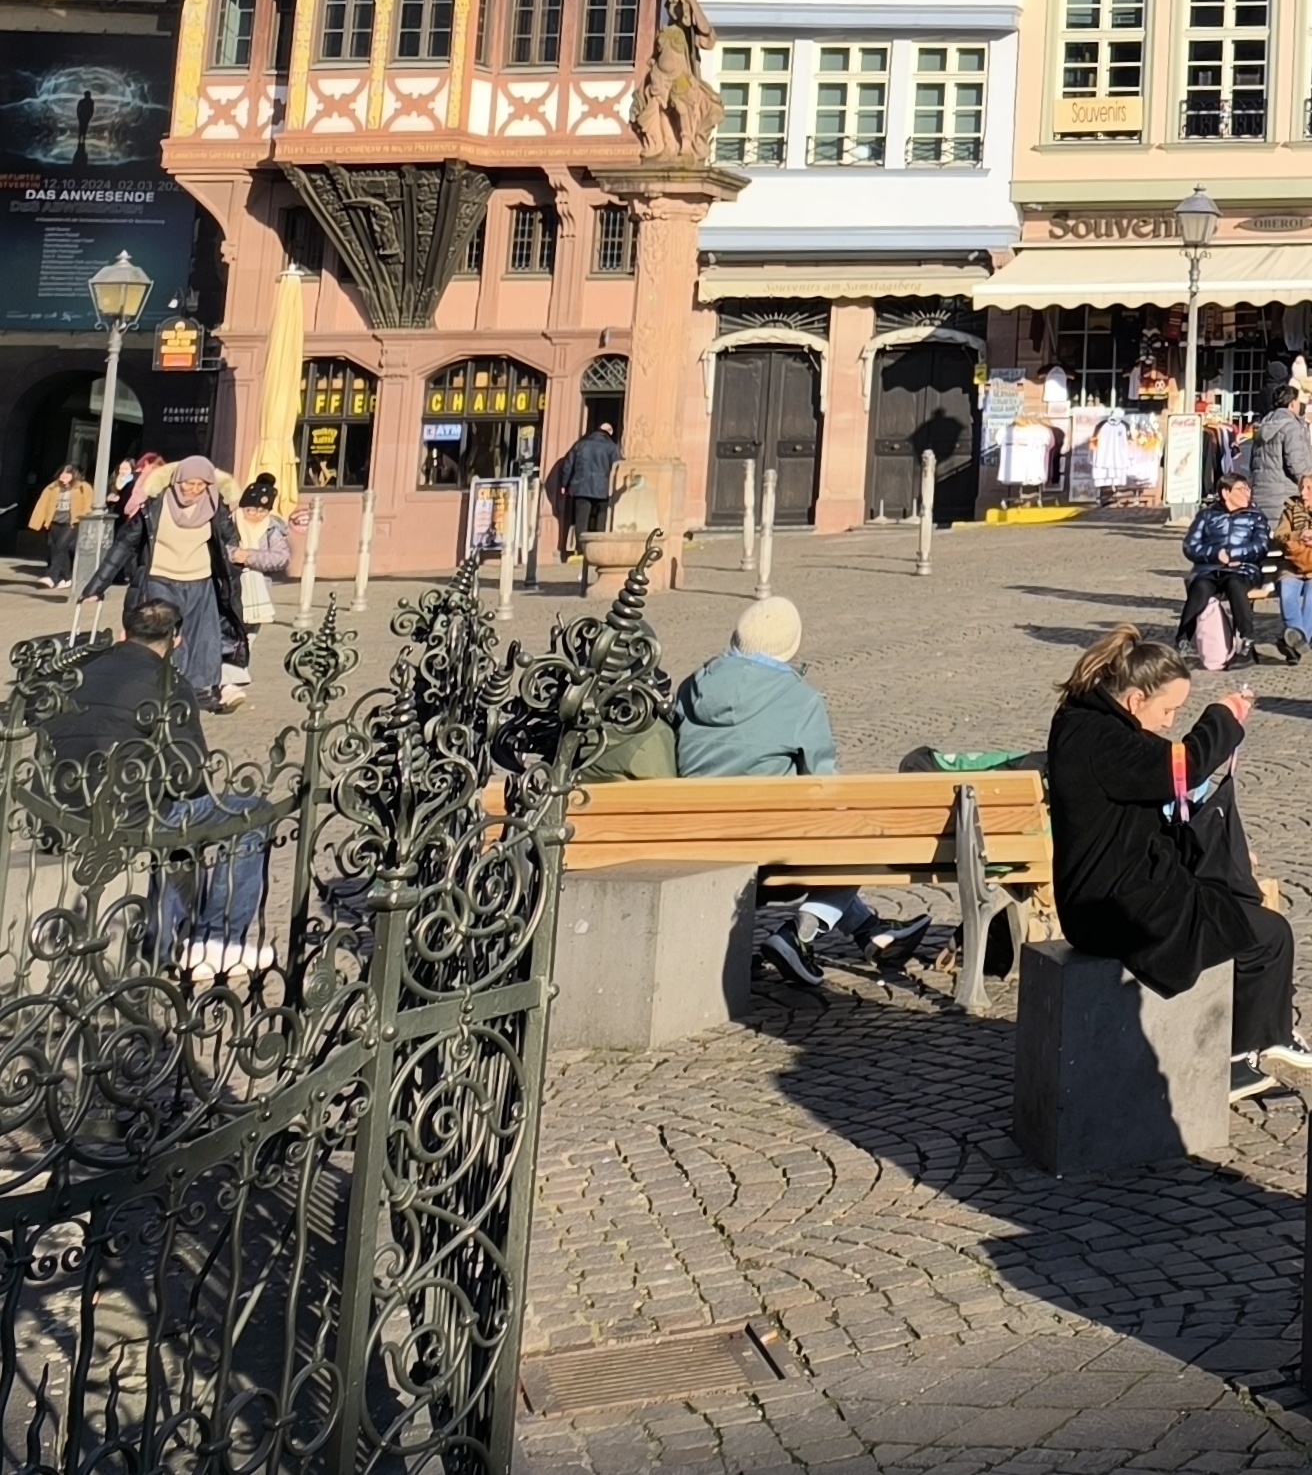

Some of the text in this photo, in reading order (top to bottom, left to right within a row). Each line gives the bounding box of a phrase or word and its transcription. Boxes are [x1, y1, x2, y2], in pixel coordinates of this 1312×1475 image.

[1071, 101, 1127, 124] Souvenirs
[43, 178, 112, 190] 12.10.2024
[25, 189, 155, 203] DAS ANWESENDE
[763, 280, 923, 293] Souvenirs am Samstagsberg
[298, 393, 377, 414] FFEE
[431, 392, 546, 412] CHANGE
[435, 424, 462, 436] ATM
